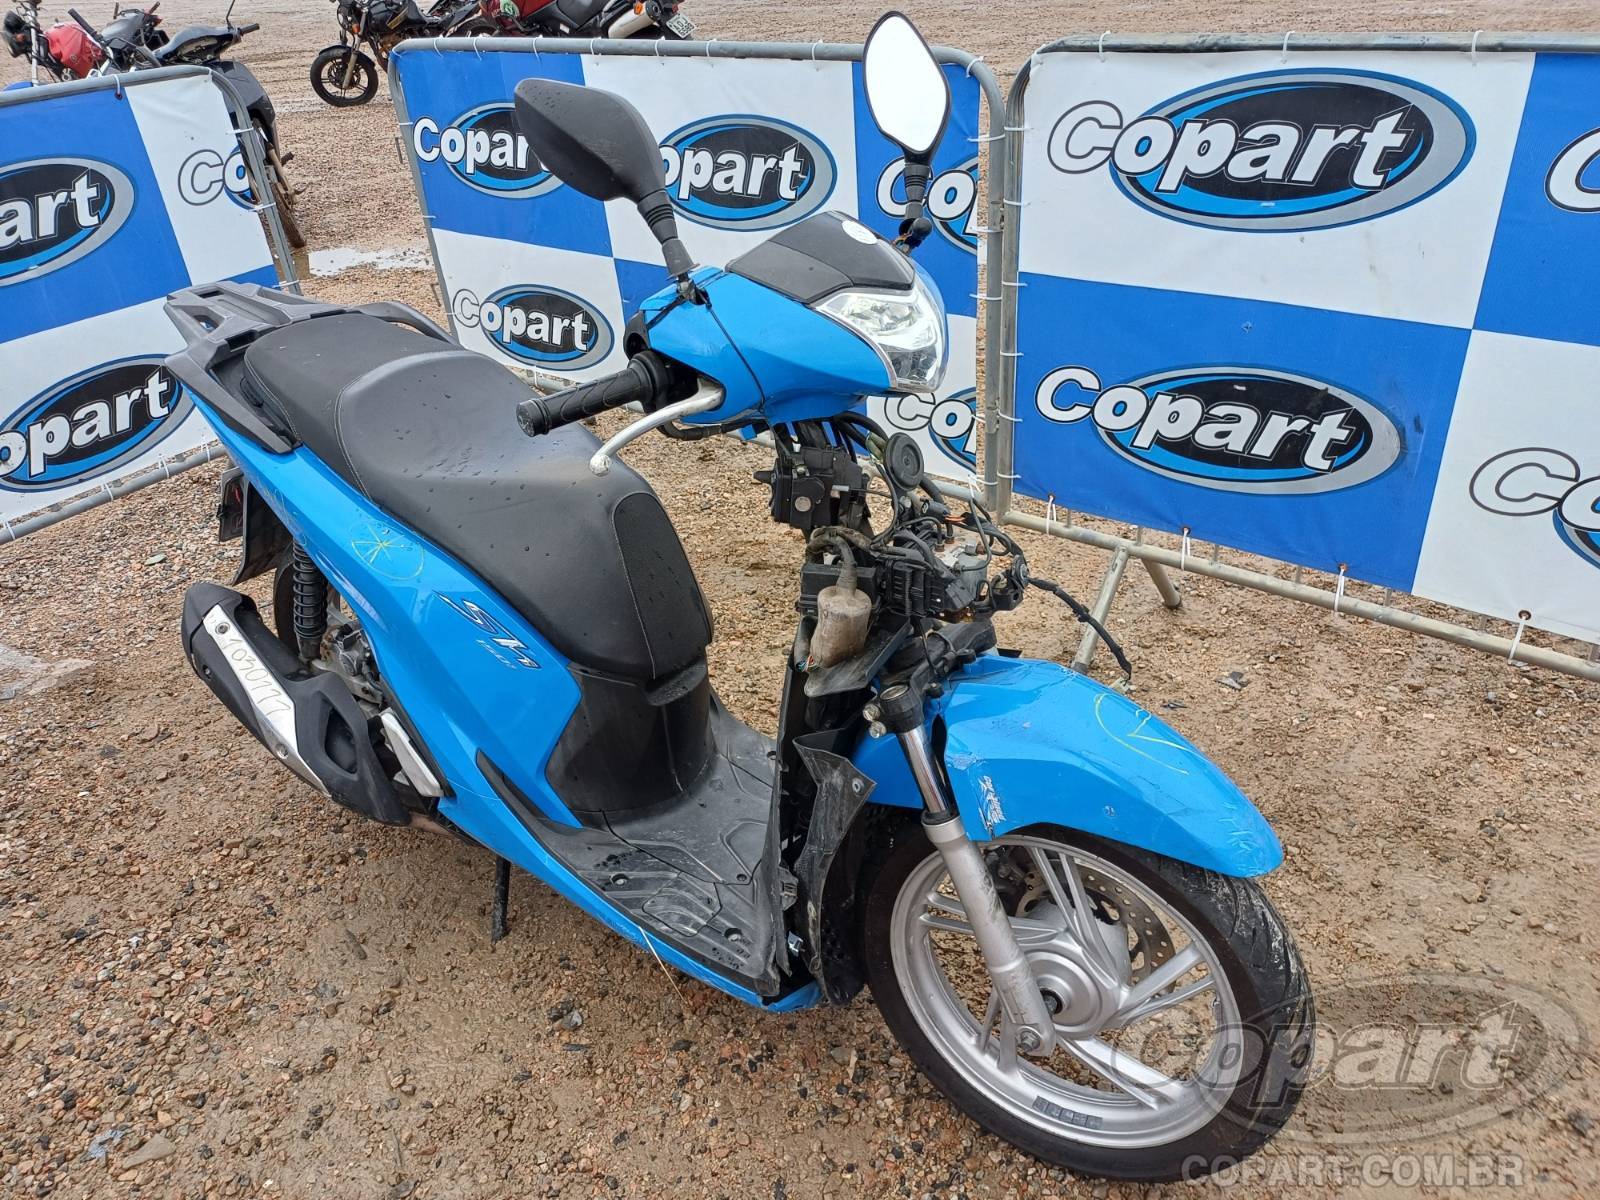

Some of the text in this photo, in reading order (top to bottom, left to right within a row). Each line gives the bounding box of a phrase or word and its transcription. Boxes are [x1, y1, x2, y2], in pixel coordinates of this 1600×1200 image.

[413, 116, 549, 175] Copar
[1048, 99, 1414, 193] Copart
[876, 156, 977, 237] Co
[453, 288, 592, 352] Copart
[884, 392, 976, 455] Co
[1035, 366, 1358, 474] Copart
